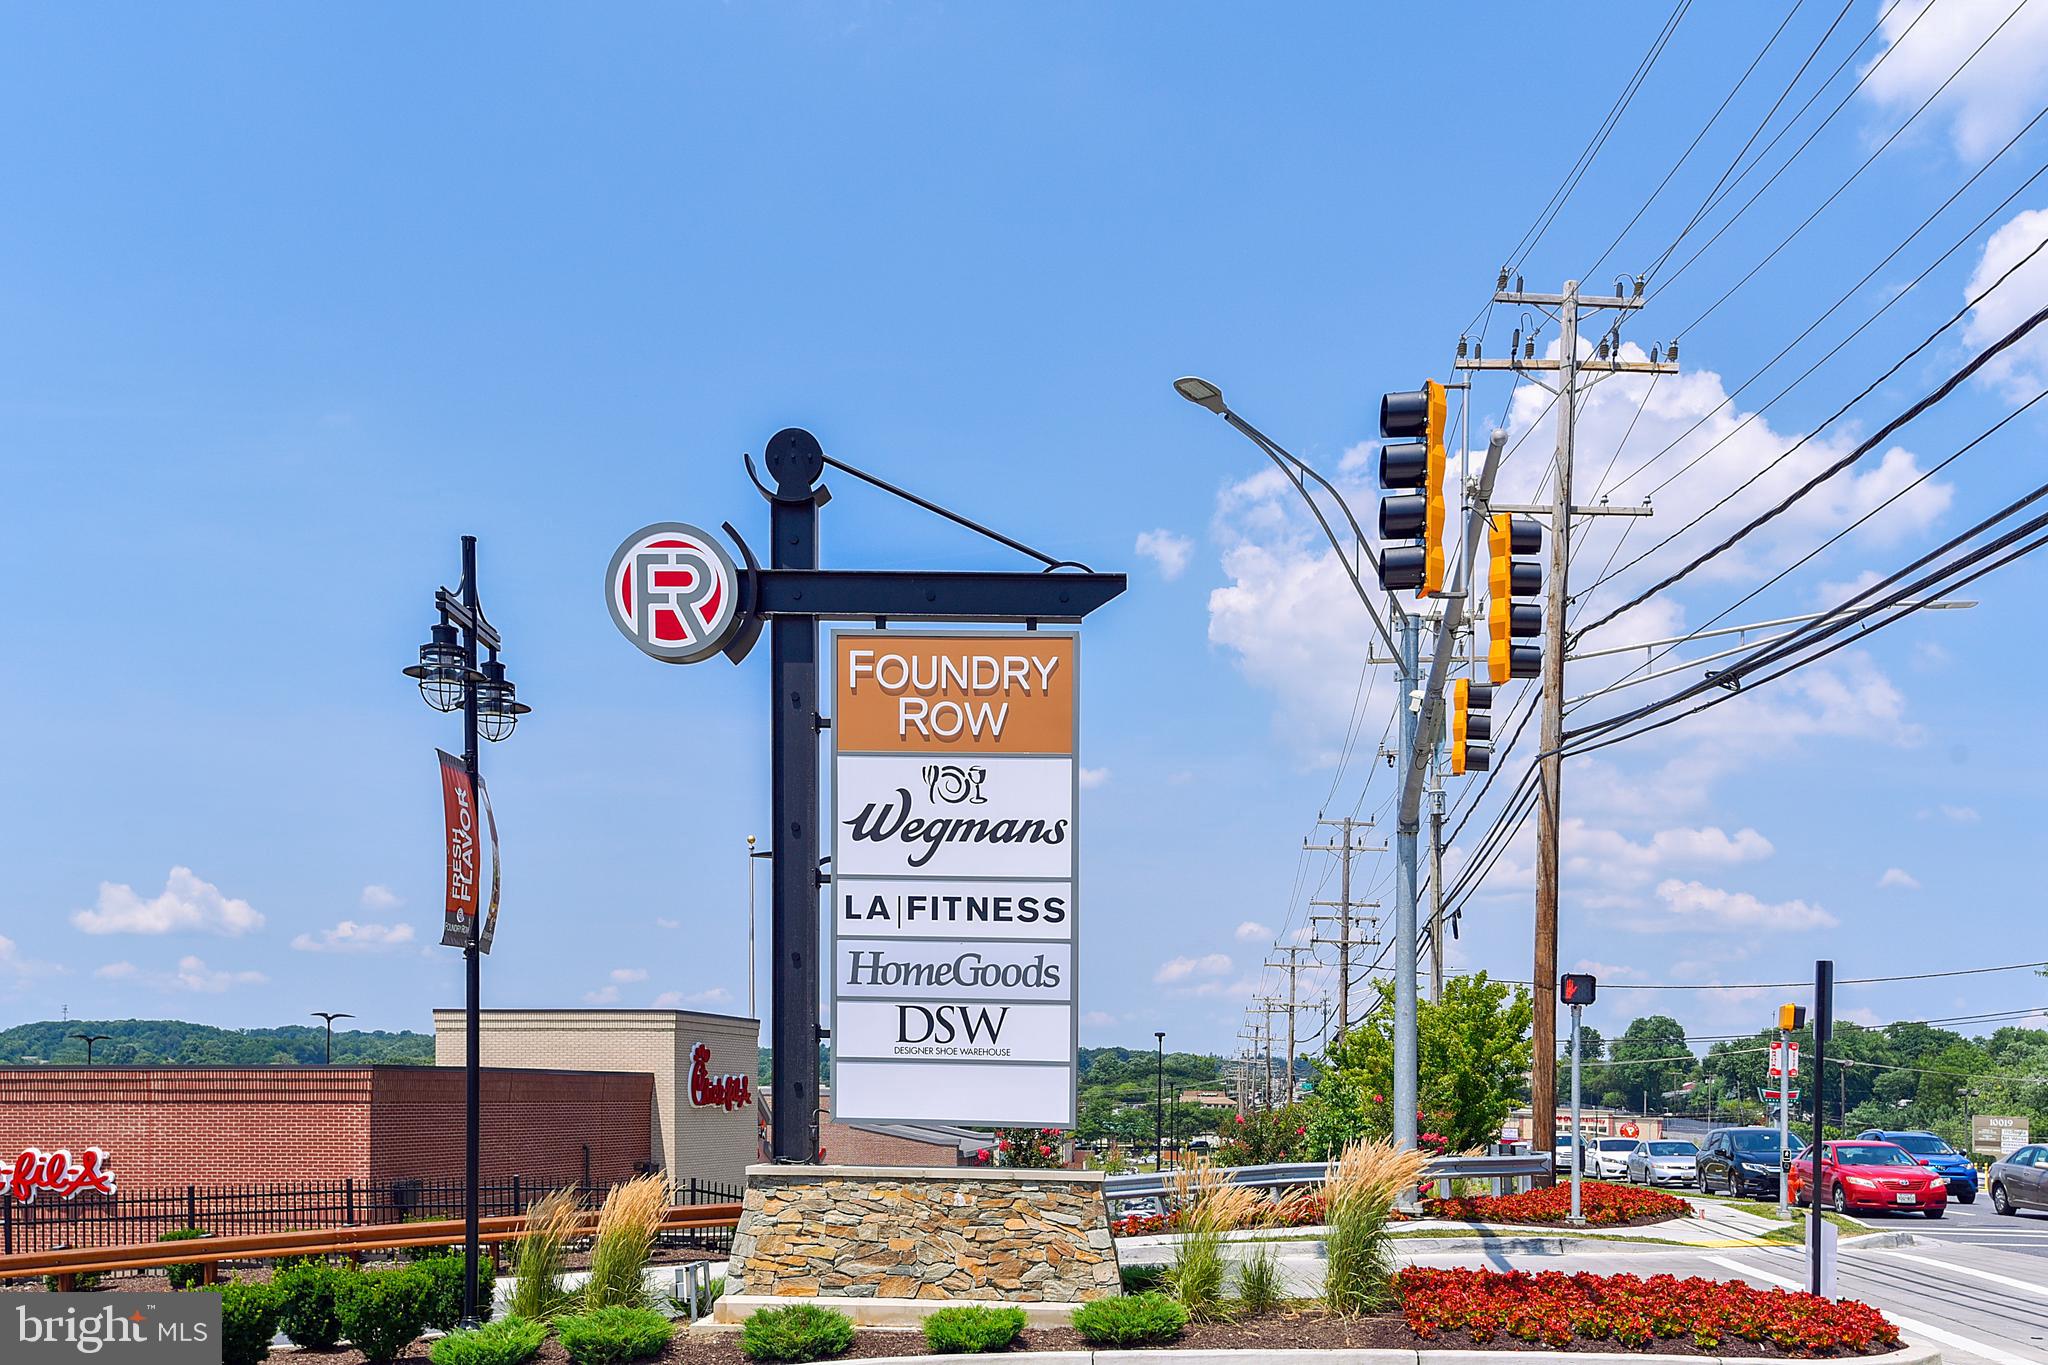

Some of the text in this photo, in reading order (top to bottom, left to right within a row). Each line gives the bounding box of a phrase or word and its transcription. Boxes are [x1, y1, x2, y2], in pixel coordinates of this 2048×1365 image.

[849, 650, 1059, 692] FOUNDRY
[899, 697, 1010, 737] ROW
[455, 786, 473, 902] FLAVOR
[842, 788, 1068, 867] Wegmans
[452, 828, 461, 899] FRESH
[907, 896, 1066, 923] FITNESS
[847, 950, 1061, 988] HomeGoods
[895, 1005, 1011, 1045] DSW
[894, 1046, 1011, 1057] DESIGNER SHOE WAREHOUSE
[1989, 1118, 2013, 1127] 10019
